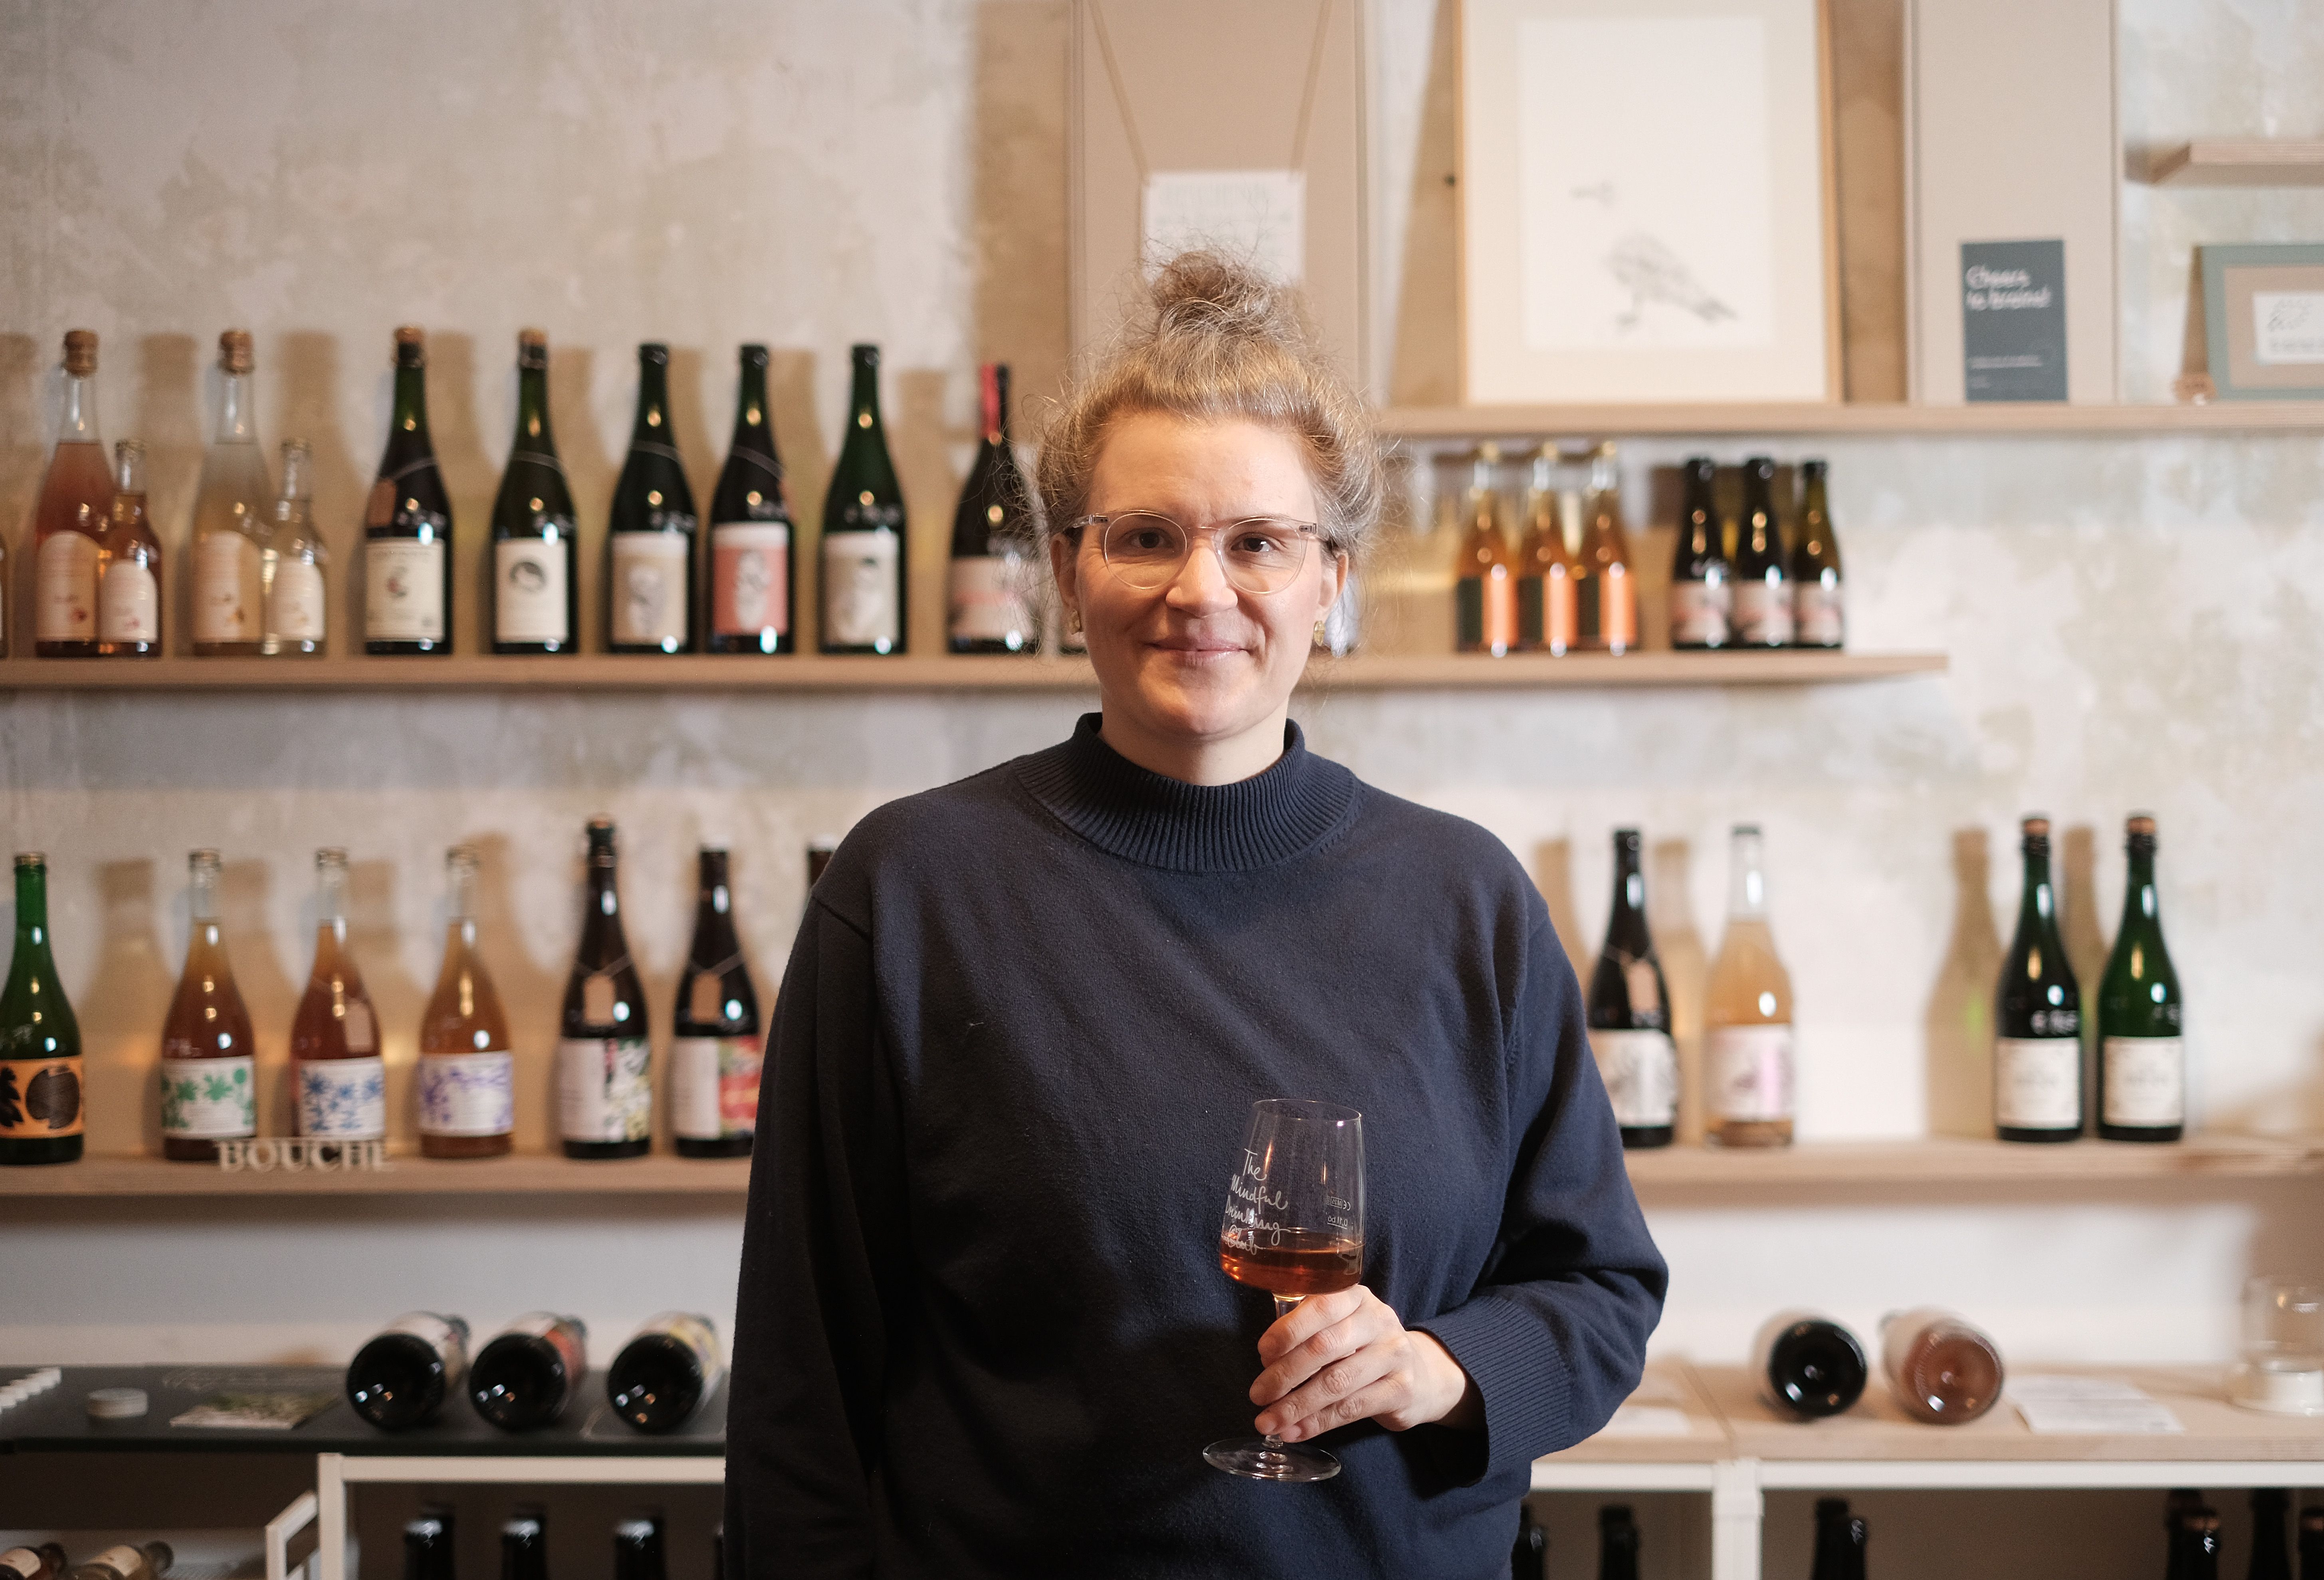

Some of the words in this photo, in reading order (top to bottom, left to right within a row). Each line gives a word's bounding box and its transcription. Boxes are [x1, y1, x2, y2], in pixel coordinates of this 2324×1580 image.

[1242, 1148, 1267, 1181] The
[1230, 1173, 1288, 1215] Mindful
[1225, 1194, 1291, 1246] Drinking
